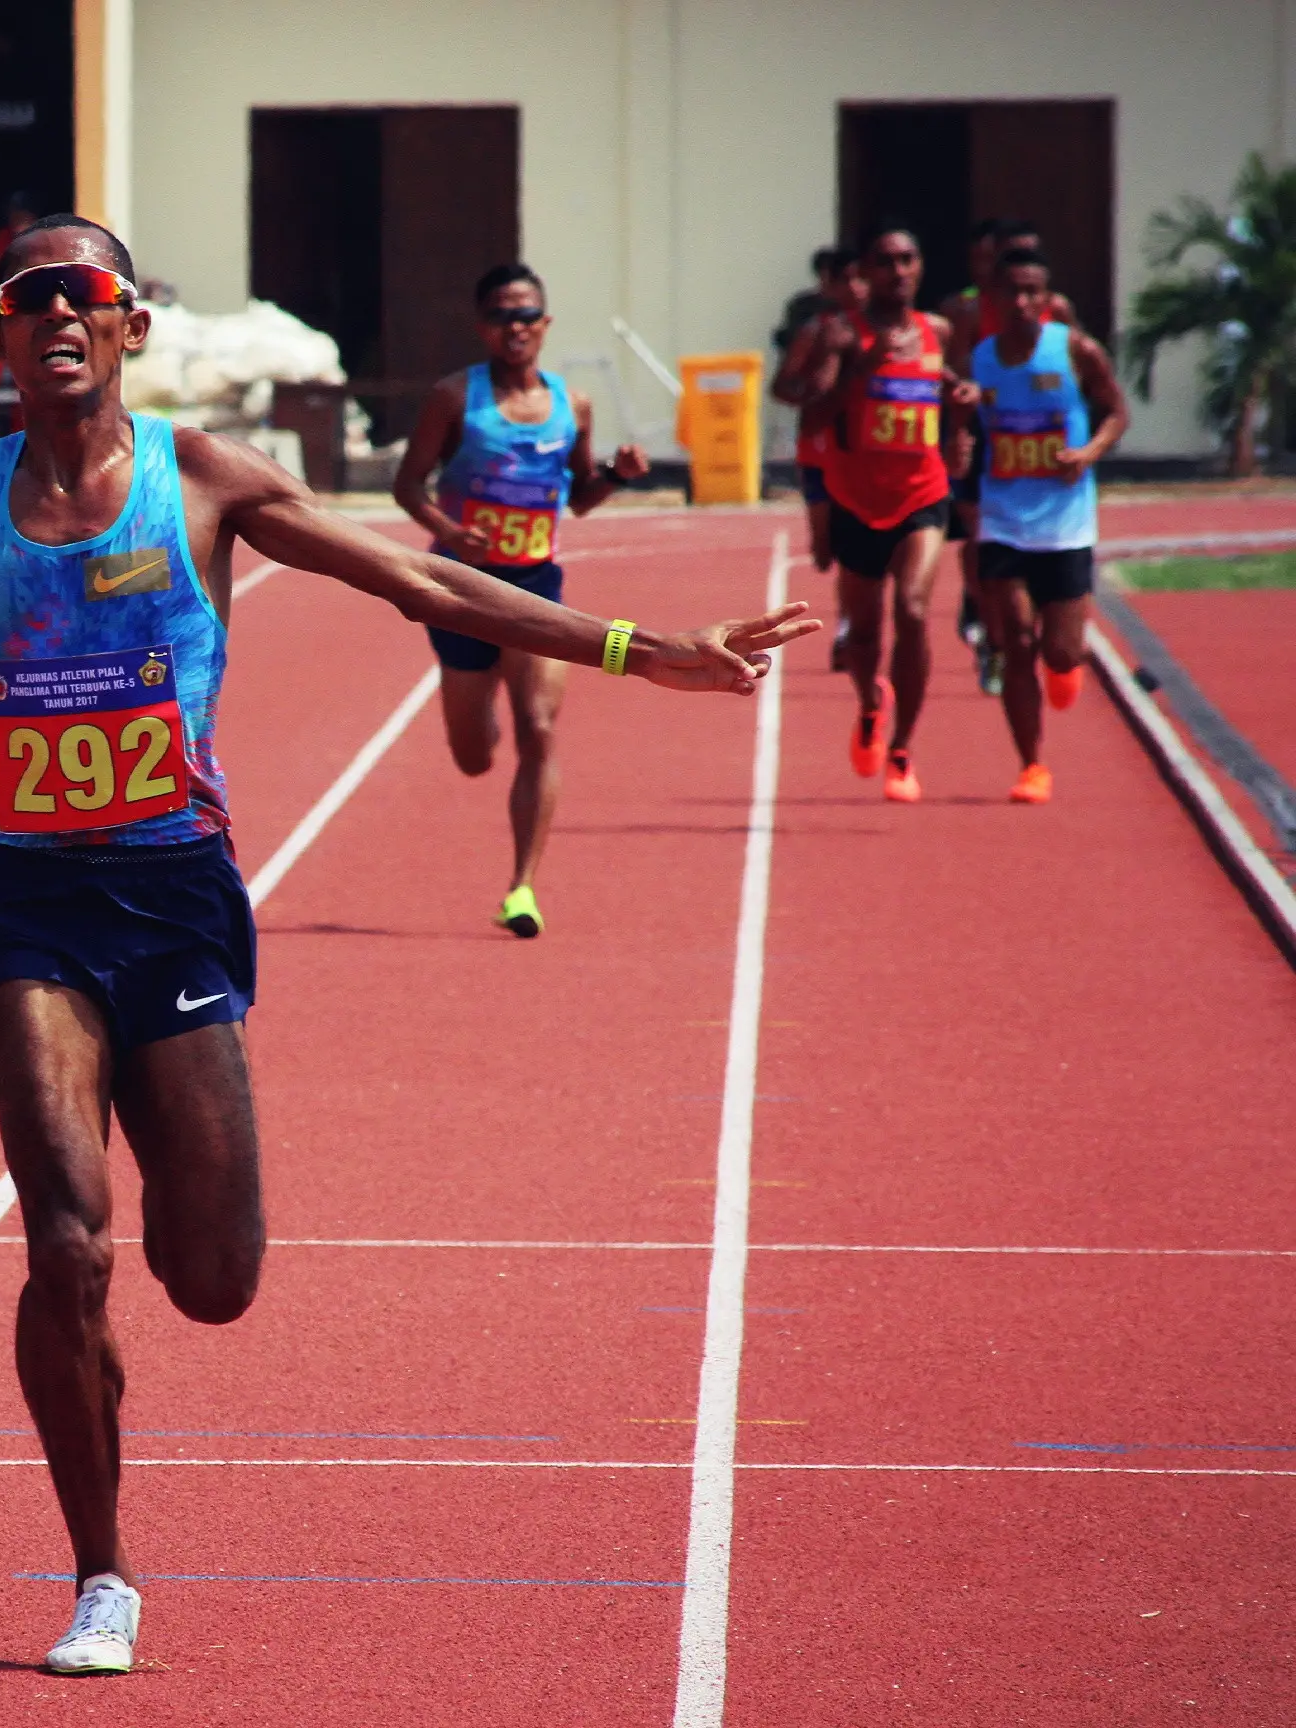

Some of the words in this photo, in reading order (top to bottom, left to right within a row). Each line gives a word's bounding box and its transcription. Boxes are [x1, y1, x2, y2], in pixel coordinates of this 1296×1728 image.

[16, 671, 59, 684] KEJURNAS
[61, 669, 96, 681] ATLETIK
[98, 666, 125, 678] PIALA
[10, 685, 51, 697] PANGLIMA
[53, 685, 68, 695] TNI
[70, 681, 112, 694] TERBUKA
[113, 677, 136, 690] KE-5
[43, 697, 74, 708] TAHUN
[75, 695, 98, 707] 2017
[8, 716, 176, 813] 292
